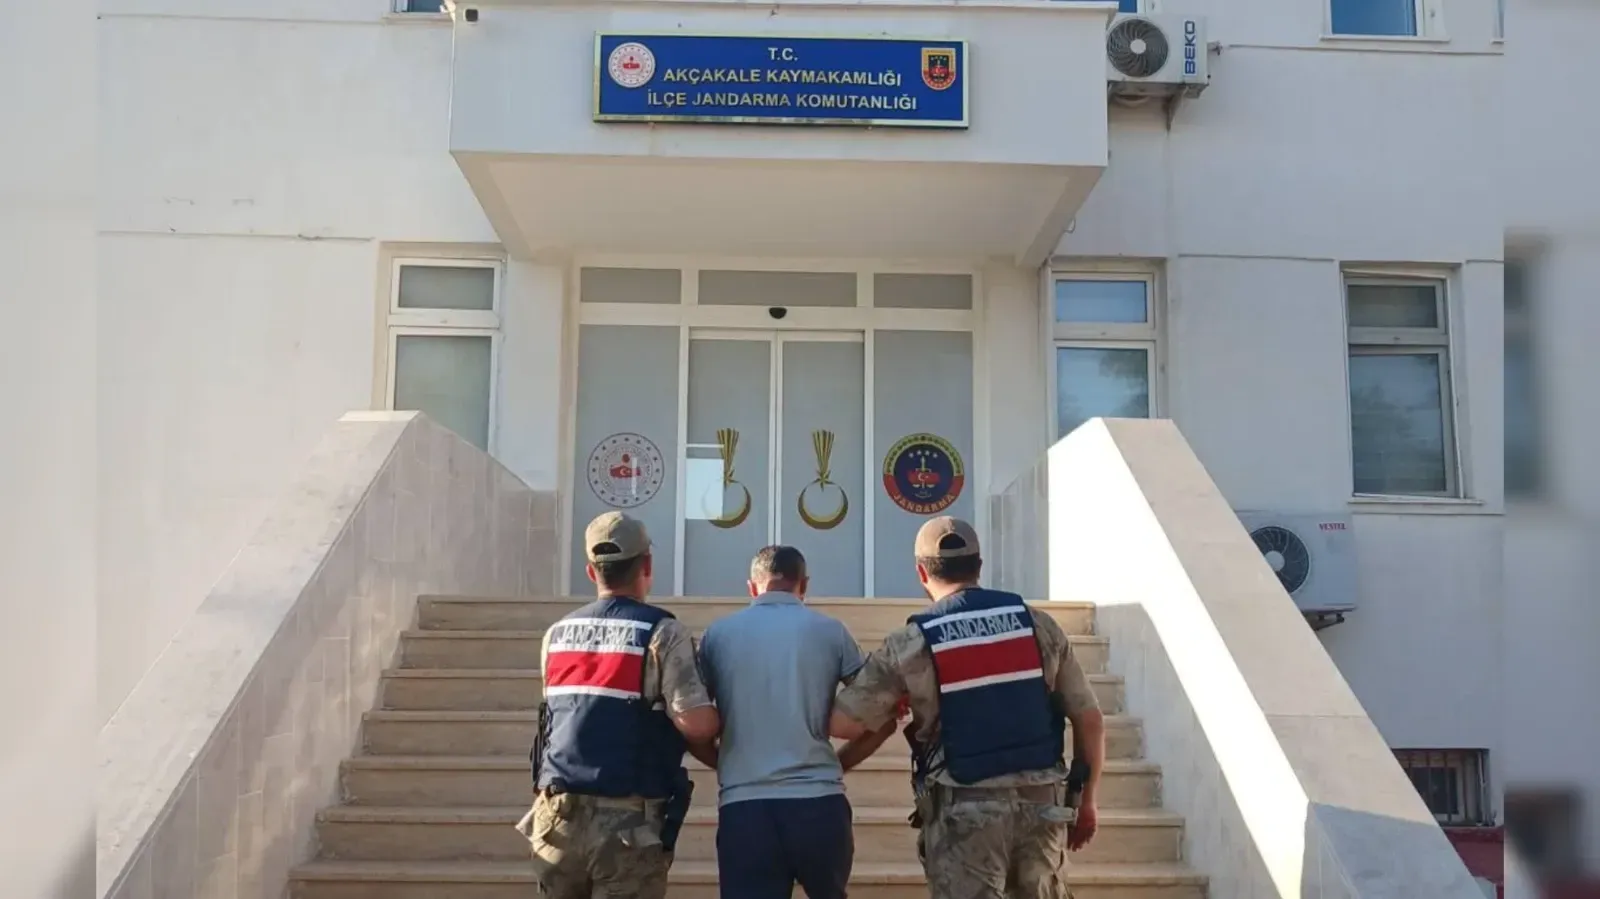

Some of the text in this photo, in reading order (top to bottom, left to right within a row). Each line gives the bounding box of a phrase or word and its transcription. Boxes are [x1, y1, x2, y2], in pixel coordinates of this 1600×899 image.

[768, 47, 798, 61] T.C.
[1184, 20, 1196, 75] BEKO
[663, 68, 901, 87] AKÇAKALE KAYMAKAMLIĞI
[647, 88, 917, 110] İLÇE JANDARMA KOMUTANLIĞI
[556, 624, 637, 646] JANDARMA
[938, 612, 1023, 643] JANDARMA
